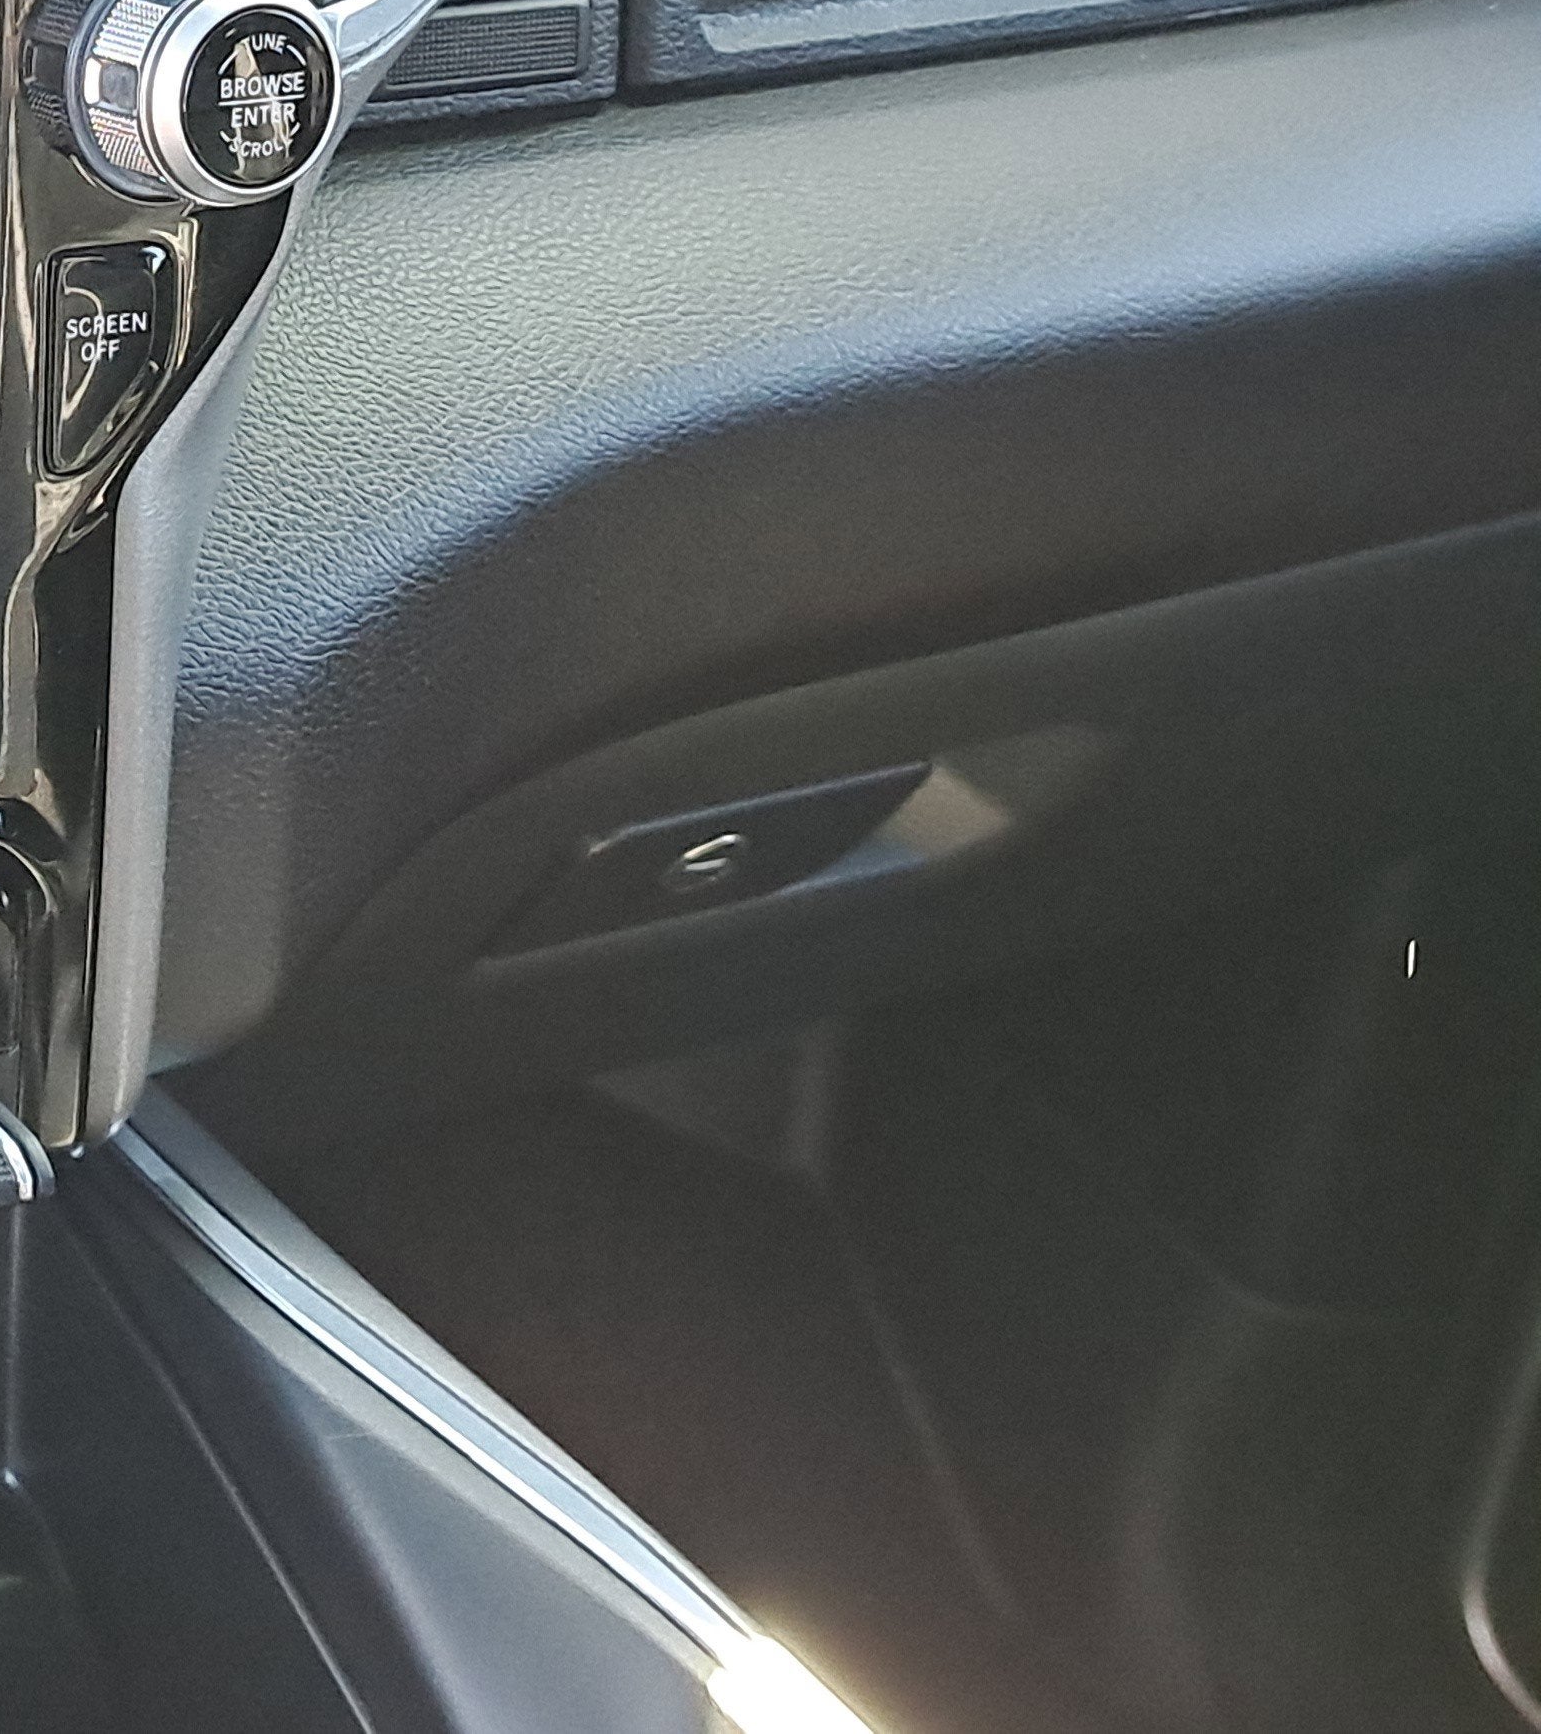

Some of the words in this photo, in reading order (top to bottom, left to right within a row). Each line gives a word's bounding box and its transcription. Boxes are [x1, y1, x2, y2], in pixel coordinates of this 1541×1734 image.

[219, 70, 306, 100] BROWSE
[230, 102, 296, 129] ENTER
[65, 312, 148, 340] SCREEN
[80, 339, 121, 362] OFF
